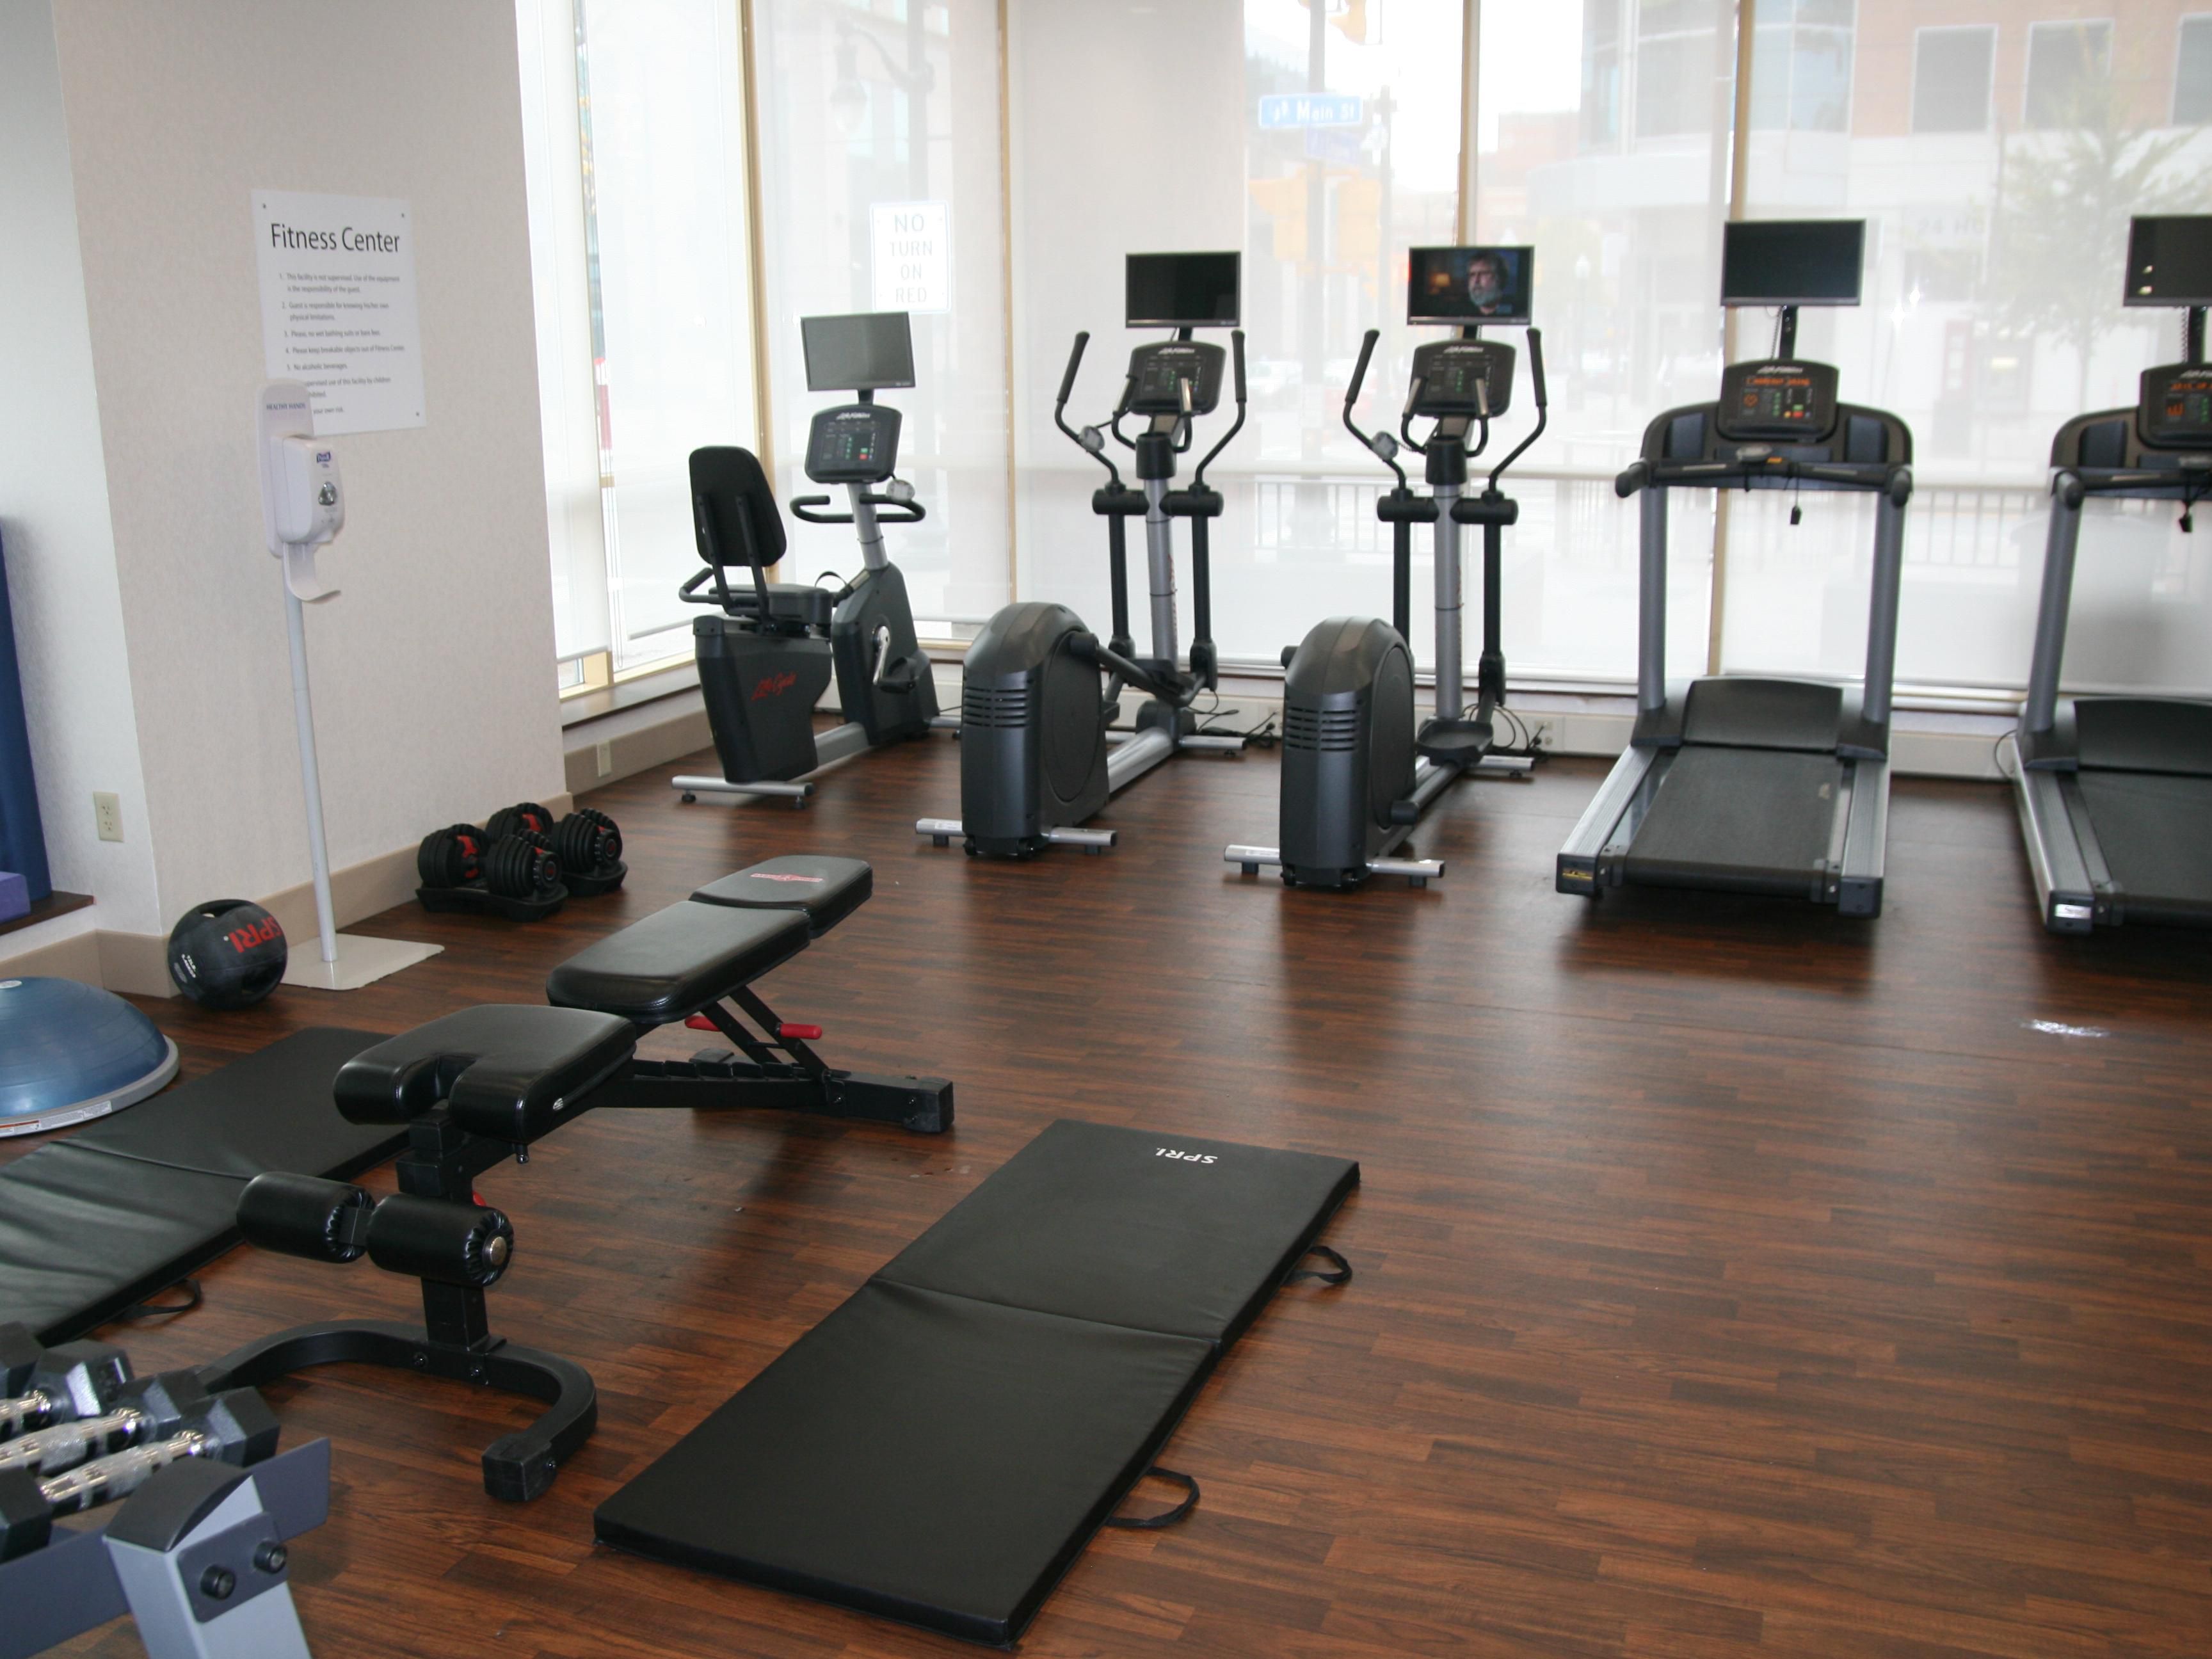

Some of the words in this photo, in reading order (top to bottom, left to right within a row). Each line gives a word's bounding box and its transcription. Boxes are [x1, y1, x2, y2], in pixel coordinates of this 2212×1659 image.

[1296, 99, 1333, 122] Main
[894, 212, 925, 233] NO
[271, 223, 337, 250] Fitness
[341, 227, 400, 253] Center
[890, 239, 933, 257] TURN
[900, 262, 922, 280] ON
[895, 287, 927, 303] RED
[228, 916, 282, 953] SPRI
[1155, 1148, 1218, 1164] SPRI
